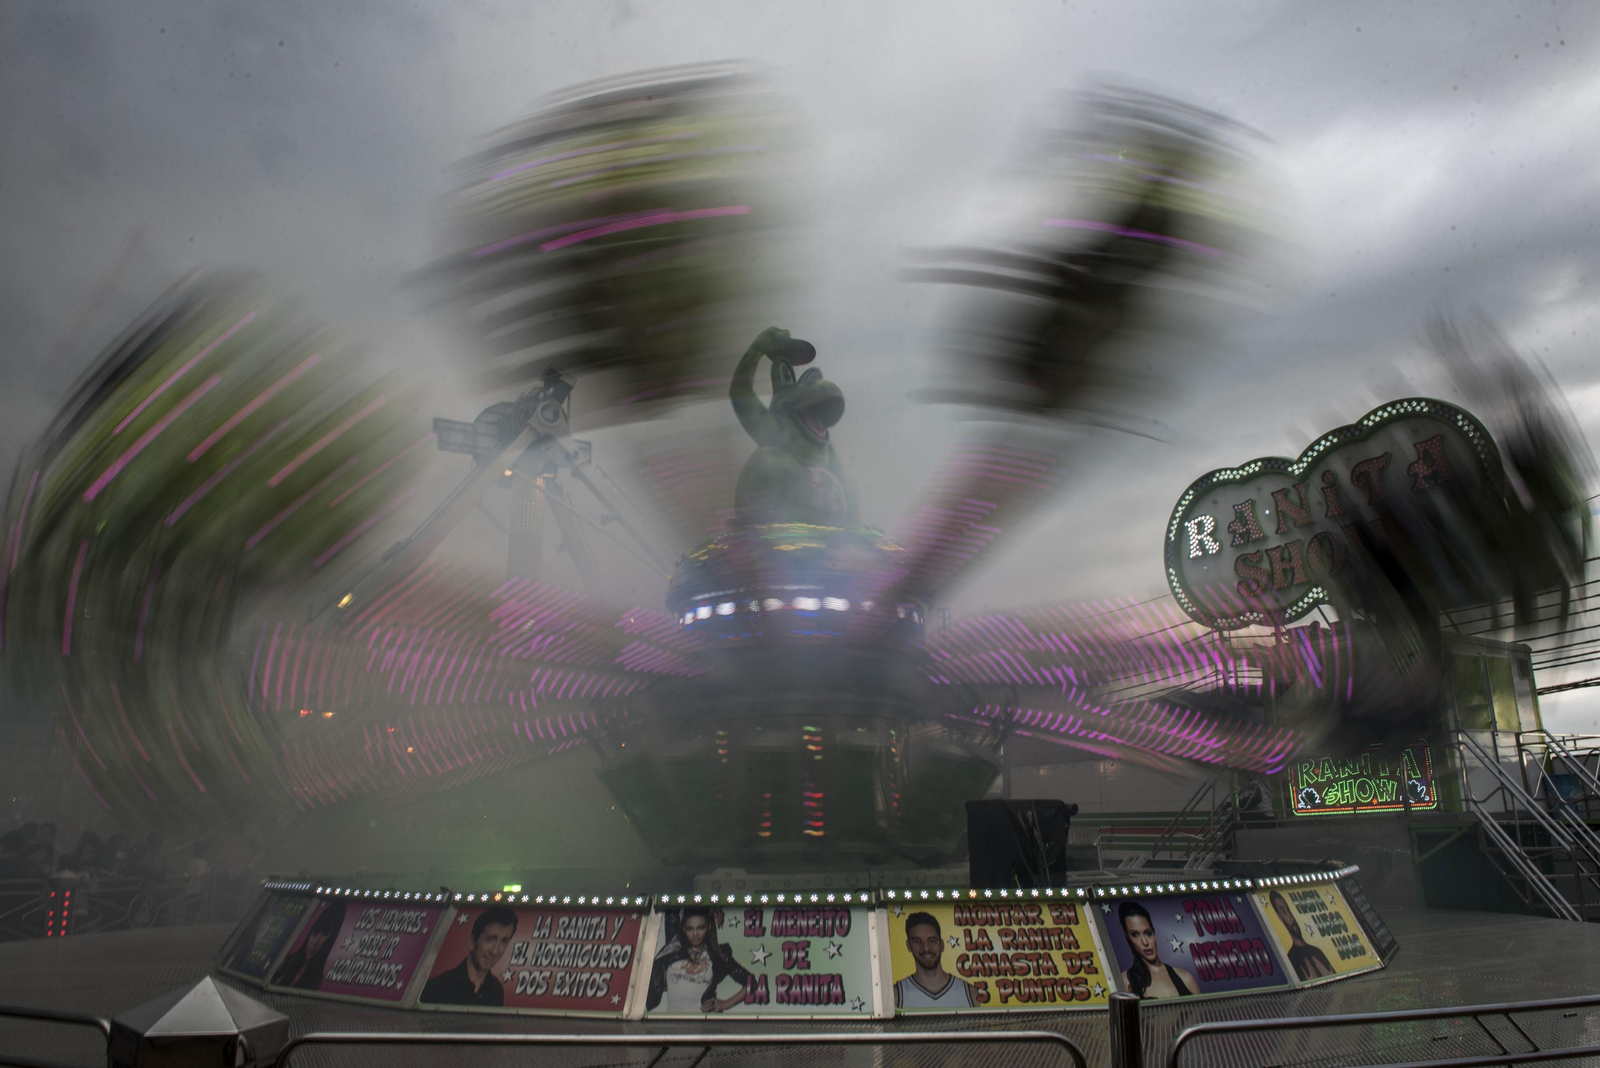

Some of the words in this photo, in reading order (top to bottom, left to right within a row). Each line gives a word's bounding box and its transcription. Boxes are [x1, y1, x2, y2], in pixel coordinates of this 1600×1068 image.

[1234, 518, 1398, 596] SHO
[1322, 777, 1398, 806] SHOW
[953, 903, 1044, 926] MONTAR
[1049, 903, 1079, 926] EN
[1288, 889, 1329, 915] HASTA
[354, 908, 380, 930] LOS
[375, 909, 428, 935] MENORES
[531, 915, 554, 939] LA
[555, 915, 610, 941] RANITA
[610, 916, 625, 940] Y
[743, 908, 766, 938] EL
[770, 907, 851, 938] MENEITO
[1183, 897, 1246, 937] TOMA
[1312, 910, 1349, 938] LUEGO
[353, 935, 385, 957] DEBE
[382, 936, 400, 960] IR
[964, 928, 994, 952] LA
[997, 927, 1080, 952] RANITA
[1331, 933, 1367, 961] LUCAS
[510, 942, 530, 968] EL
[530, 942, 633, 971] HORMIGUERO
[782, 940, 811, 970] DE
[955, 952, 1058, 978] CANASTA
[1062, 951, 1098, 976] DE
[1189, 937, 1274, 983] MENEITO
[514, 969, 550, 997] DOS
[551, 970, 613, 999] EXITOS
[745, 973, 770, 1004] LA
[773, 974, 845, 1005] RANITA
[976, 980, 991, 1004] 3
[996, 978, 1093, 1004] PUNTOS
